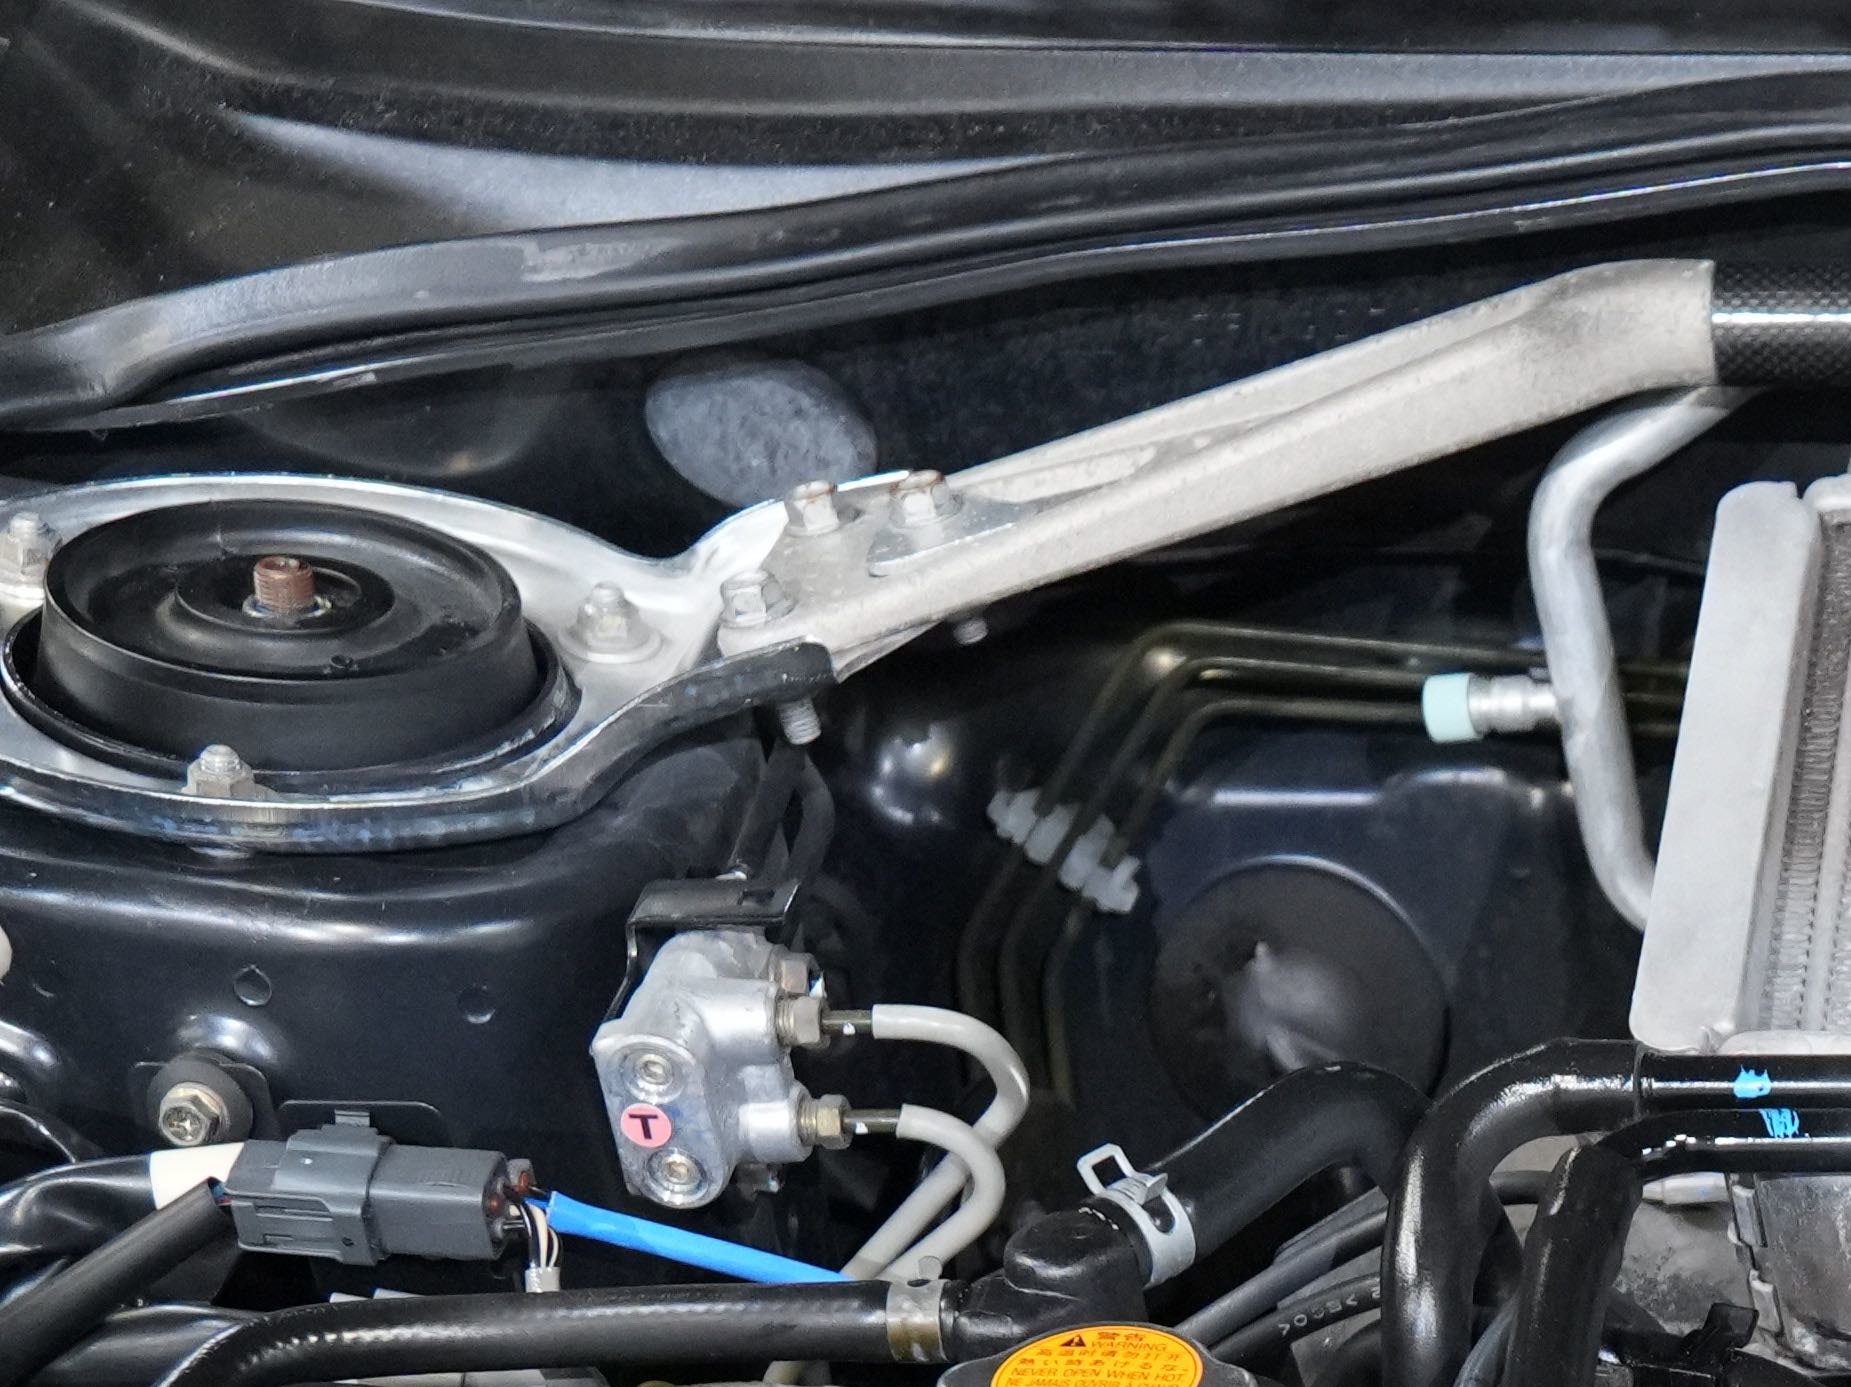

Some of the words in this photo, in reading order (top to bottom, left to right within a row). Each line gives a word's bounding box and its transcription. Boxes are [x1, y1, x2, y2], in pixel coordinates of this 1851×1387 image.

[630, 1114, 659, 1140] T
[1089, 1340, 1167, 1352] WARNING
[1011, 1367, 1057, 1377] NEVER
[1063, 1369, 1100, 1378] OPEN
[1107, 1369, 1149, 1380] WHEN
[1153, 1371, 1186, 1382] HOT
[1027, 1377, 1070, 1387] JAMAIS
